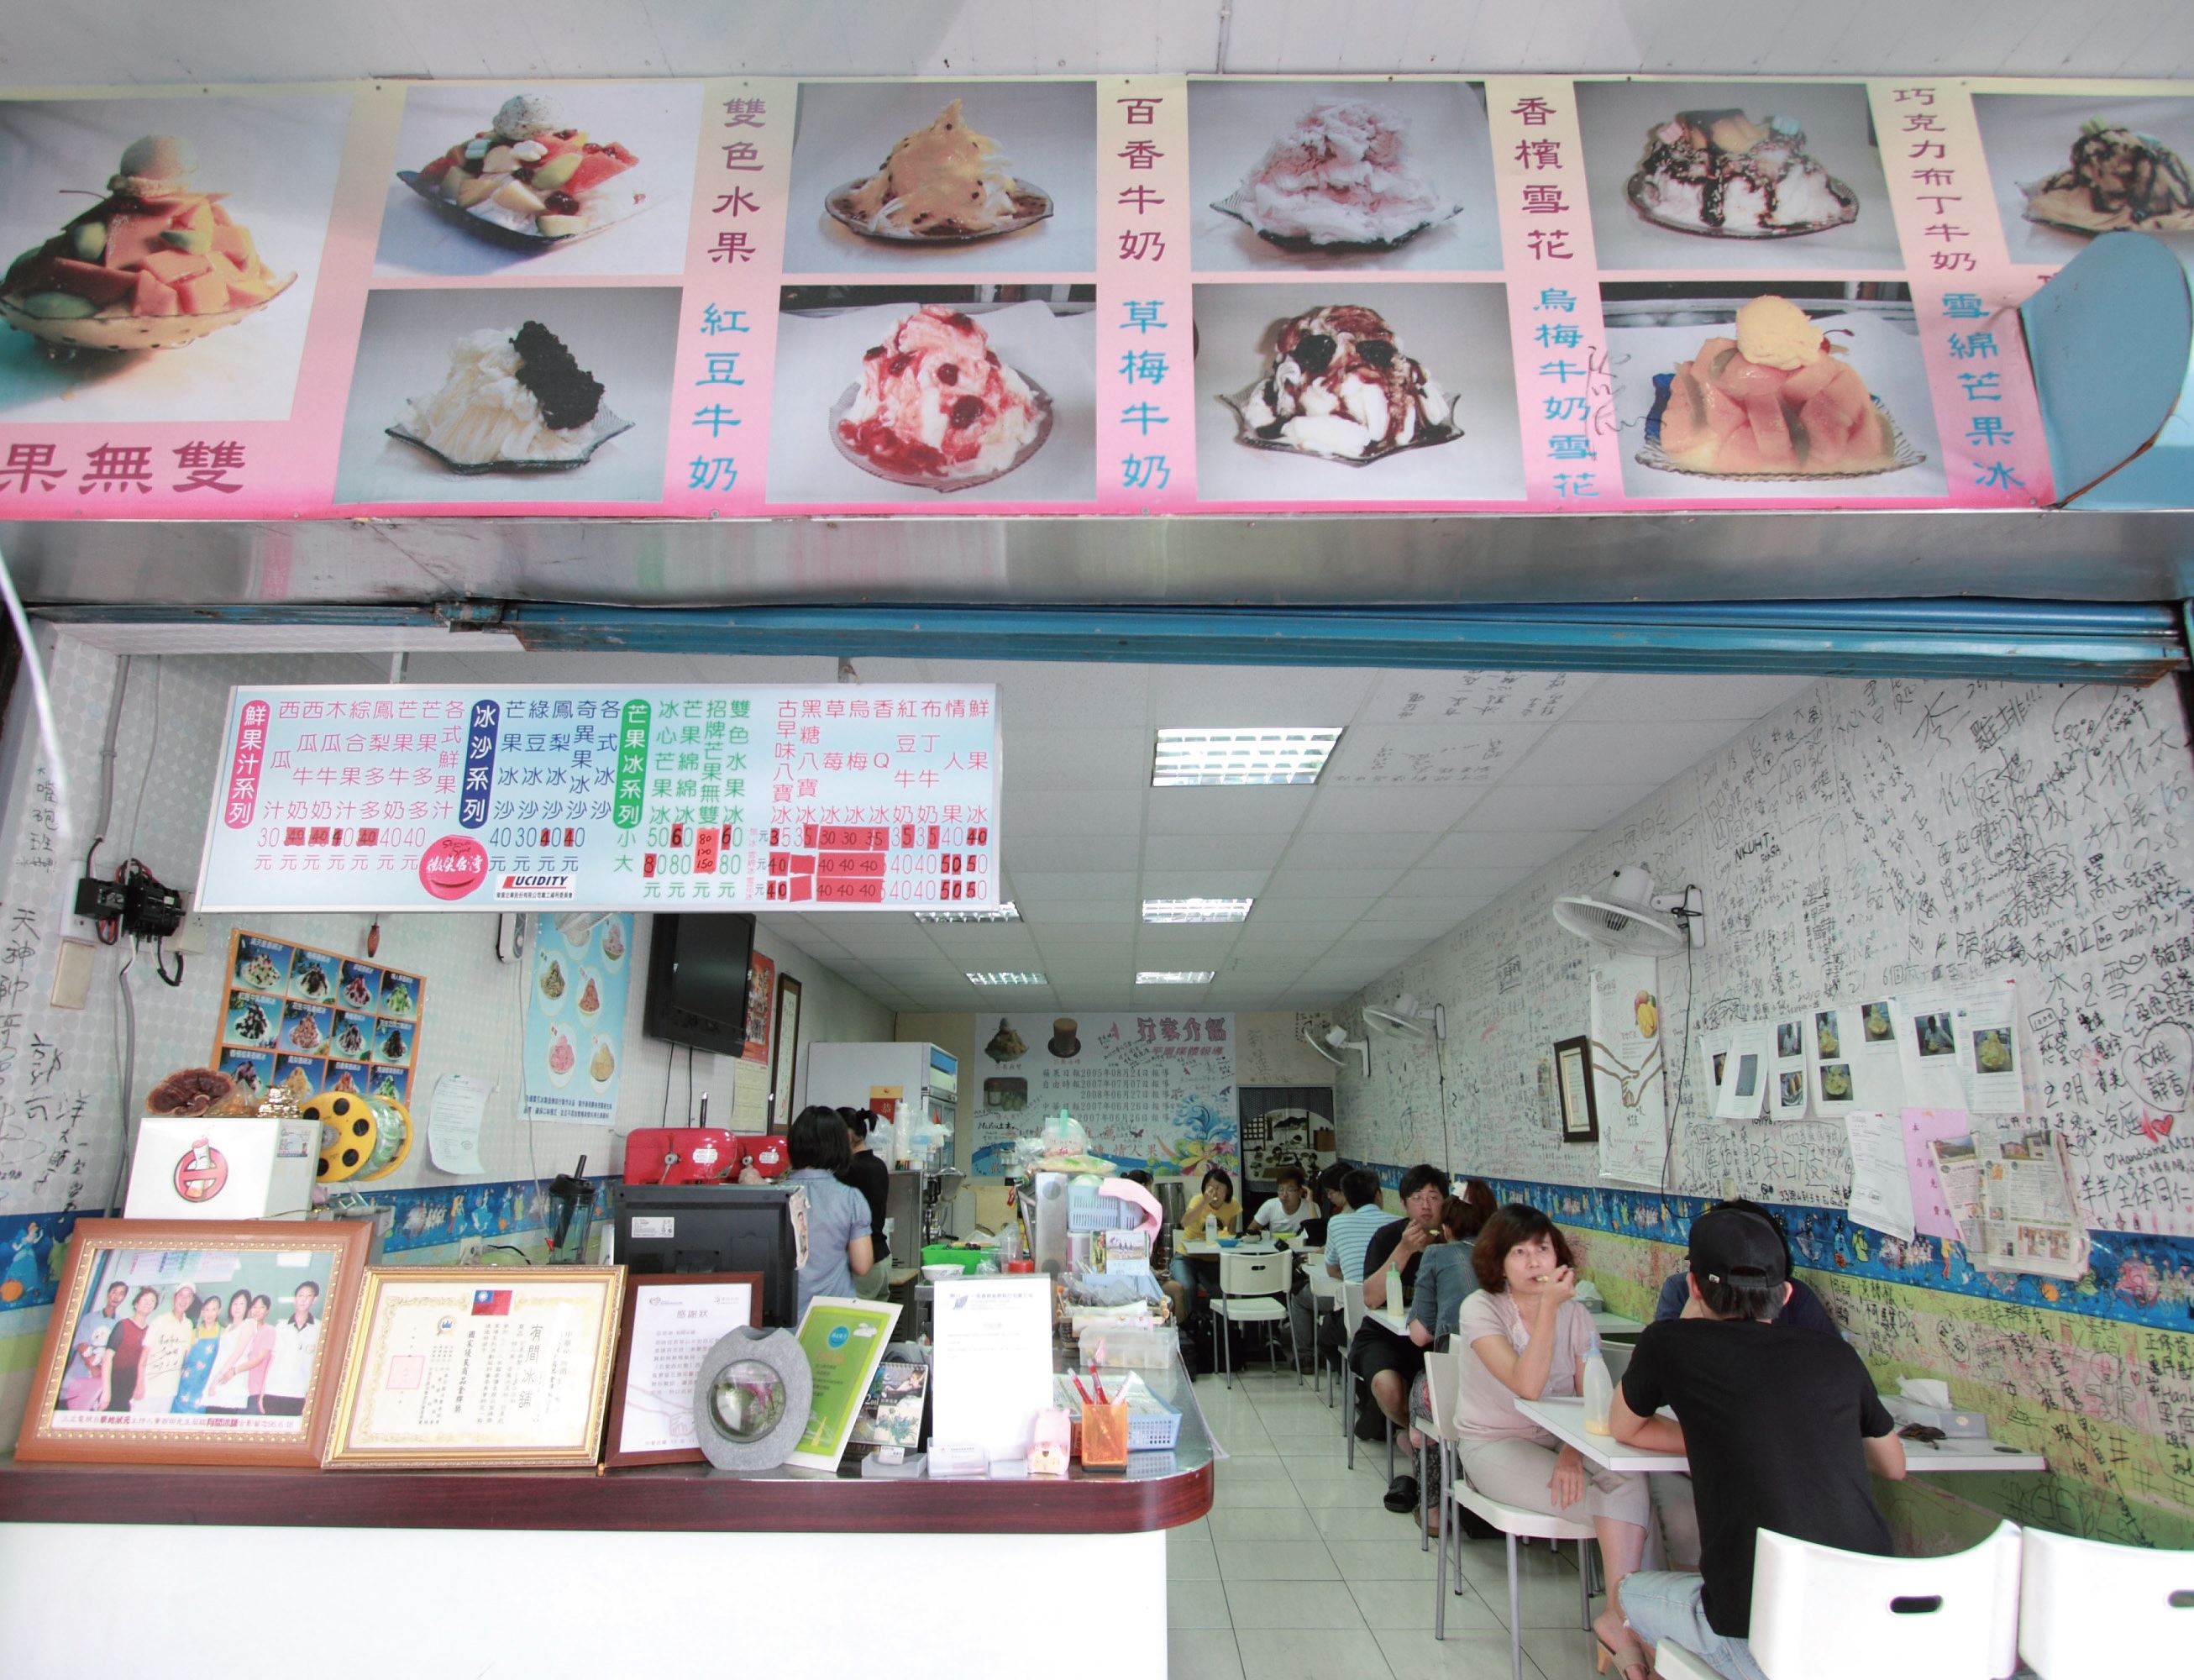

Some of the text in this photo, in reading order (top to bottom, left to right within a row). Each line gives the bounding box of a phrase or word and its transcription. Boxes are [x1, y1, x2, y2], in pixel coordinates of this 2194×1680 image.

[707, 97, 767, 264] 雙色水果
[1116, 97, 1166, 262] 百香牛奶
[1511, 97, 1575, 261] 香檳雪花
[1893, 87, 1976, 271] 巧克力布丁牛奶
[687, 302, 750, 493] 紅豆牛奶
[1119, 301, 1170, 491] 草梅牛奶
[1533, 287, 1601, 500] 烏梅牛奶雪花
[1941, 291, 2026, 491] 雪綿芒果冰
[1, 441, 246, 496] 果無雙
[228, 704, 268, 823] 鮮果汁系列
[263, 701, 301, 820] 西瓜汁
[287, 701, 325, 820] 西瓜牛奶
[311, 701, 348, 820] 木瓜牛奶
[336, 701, 371, 820] 綜合果汁
[360, 701, 394, 820] 鳳梨多多
[384, 701, 417, 820] 芒果牛奶
[408, 701, 440, 820] 芒果多多
[433, 701, 465, 820] 各式鮮果汁
[464, 705, 496, 821] 冰沙系列
[493, 701, 525, 820] 芒果冰沙
[517, 701, 549, 820] 綠豆冰沙
[542, 701, 574, 820] 鳳梨冰沙
[566, 701, 599, 820] 奇異果冰沙
[590, 701, 621, 820] 各式冰沙
[618, 705, 648, 824] 芒果冰系列
[650, 701, 679, 825] 冰心芒果冰
[674, 701, 703, 825] 芒果綿綿冰
[699, 701, 727, 825] 招牌芒果無雙
[723, 701, 751, 825] 雙色水果冰
[770, 700, 798, 824] 古早味八寶冰
[795, 700, 821, 824] 黑糖八寶冰
[820, 700, 846, 824] 草莓冰
[844, 700, 870, 824] 烏梅冰
[869, 700, 894, 824] 香Q冰
[893, 700, 917, 824] 紅豆牛奶
[917, 700, 942, 824] 布丁牛奶
[942, 700, 965, 824] 情人果
[966, 700, 989, 824] 鮮果冰
[258, 827, 280, 847] 30
[333, 827, 354, 847] 40
[381, 827, 402, 847] 40
[404, 827, 425, 847] 40
[490, 827, 511, 847] 40
[515, 827, 538, 847] 30
[540, 827, 562, 847] 40
[564, 827, 585, 847] 40
[613, 854, 633, 872] 大
[643, 854, 667, 876] 80
[669, 854, 691, 875] 80
[720, 854, 741, 875] 80
[617, 830, 636, 848] 小
[648, 827, 669, 848] 50
[671, 827, 693, 848] 60
[722, 827, 743, 848] 60
[754, 884, 764, 895] 元
[767, 881, 787, 899] 40
[816, 885, 832, 896] 40
[837, 885, 853, 896] 40
[890, 880, 912, 900] 40
[914, 880, 936, 900] 40
[940, 880, 961, 900] 50
[966, 880, 988, 900] 50
[757, 858, 766, 870] 元
[768, 854, 787, 873] 40
[818, 858, 834, 872] 40
[839, 858, 855, 872] 40
[891, 854, 913, 874] 40
[915, 854, 937, 874] 40
[941, 854, 961, 874] 50
[966, 853, 988, 874] 50
[758, 830, 769, 842] 元
[770, 827, 791, 847] 35
[794, 827, 812, 847] 35
[820, 831, 836, 845] 30
[842, 831, 858, 845] 30
[891, 827, 913, 847] 35
[916, 827, 937, 847] 35
[942, 827, 963, 847] 40
[967, 828, 987, 846] 40
